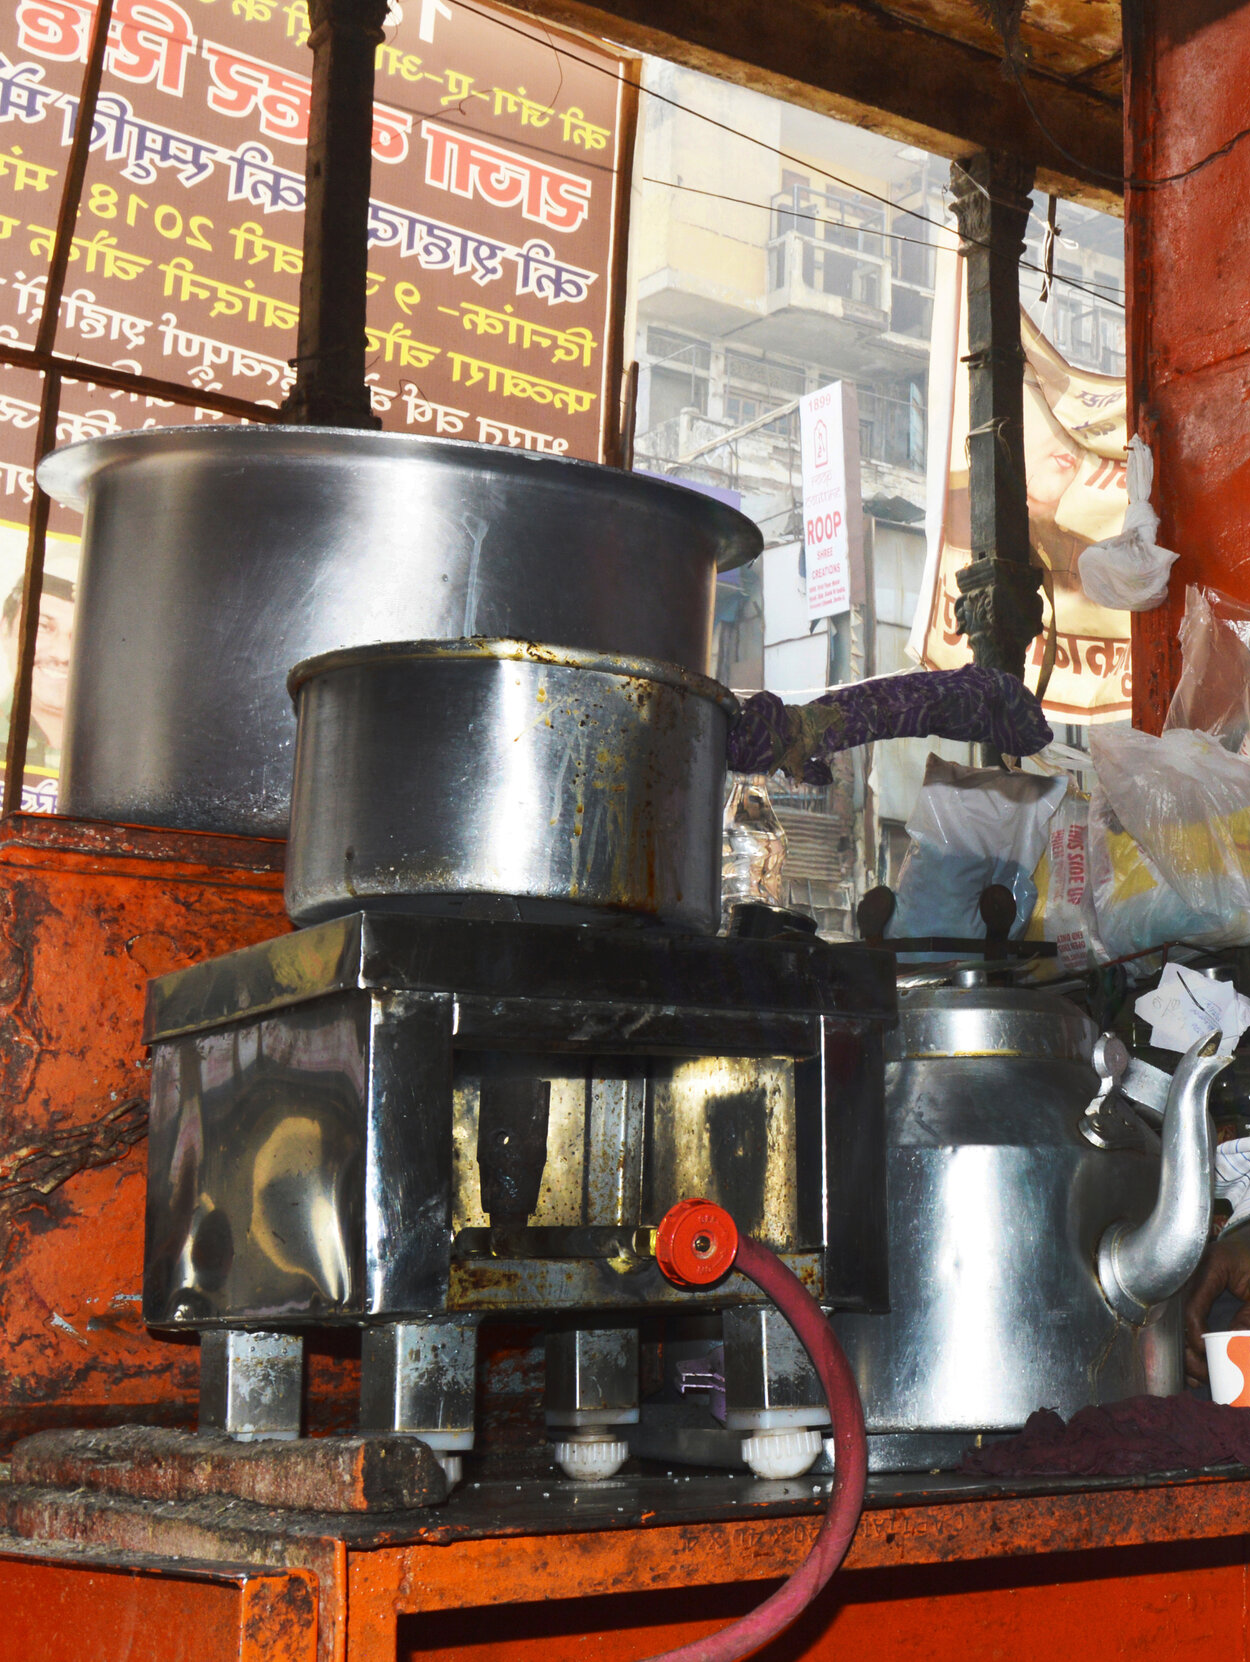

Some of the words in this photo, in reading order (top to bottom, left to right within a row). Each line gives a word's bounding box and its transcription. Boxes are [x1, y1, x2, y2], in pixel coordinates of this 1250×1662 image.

[808, 393, 831, 412] 1899
[807, 510, 841, 545] ROOP
[812, 563, 840, 580] CREATIONS
[1067, 824, 1086, 851] THIS
[1067, 853, 1085, 884] SIDE
[1067, 887, 1084, 905] UP
